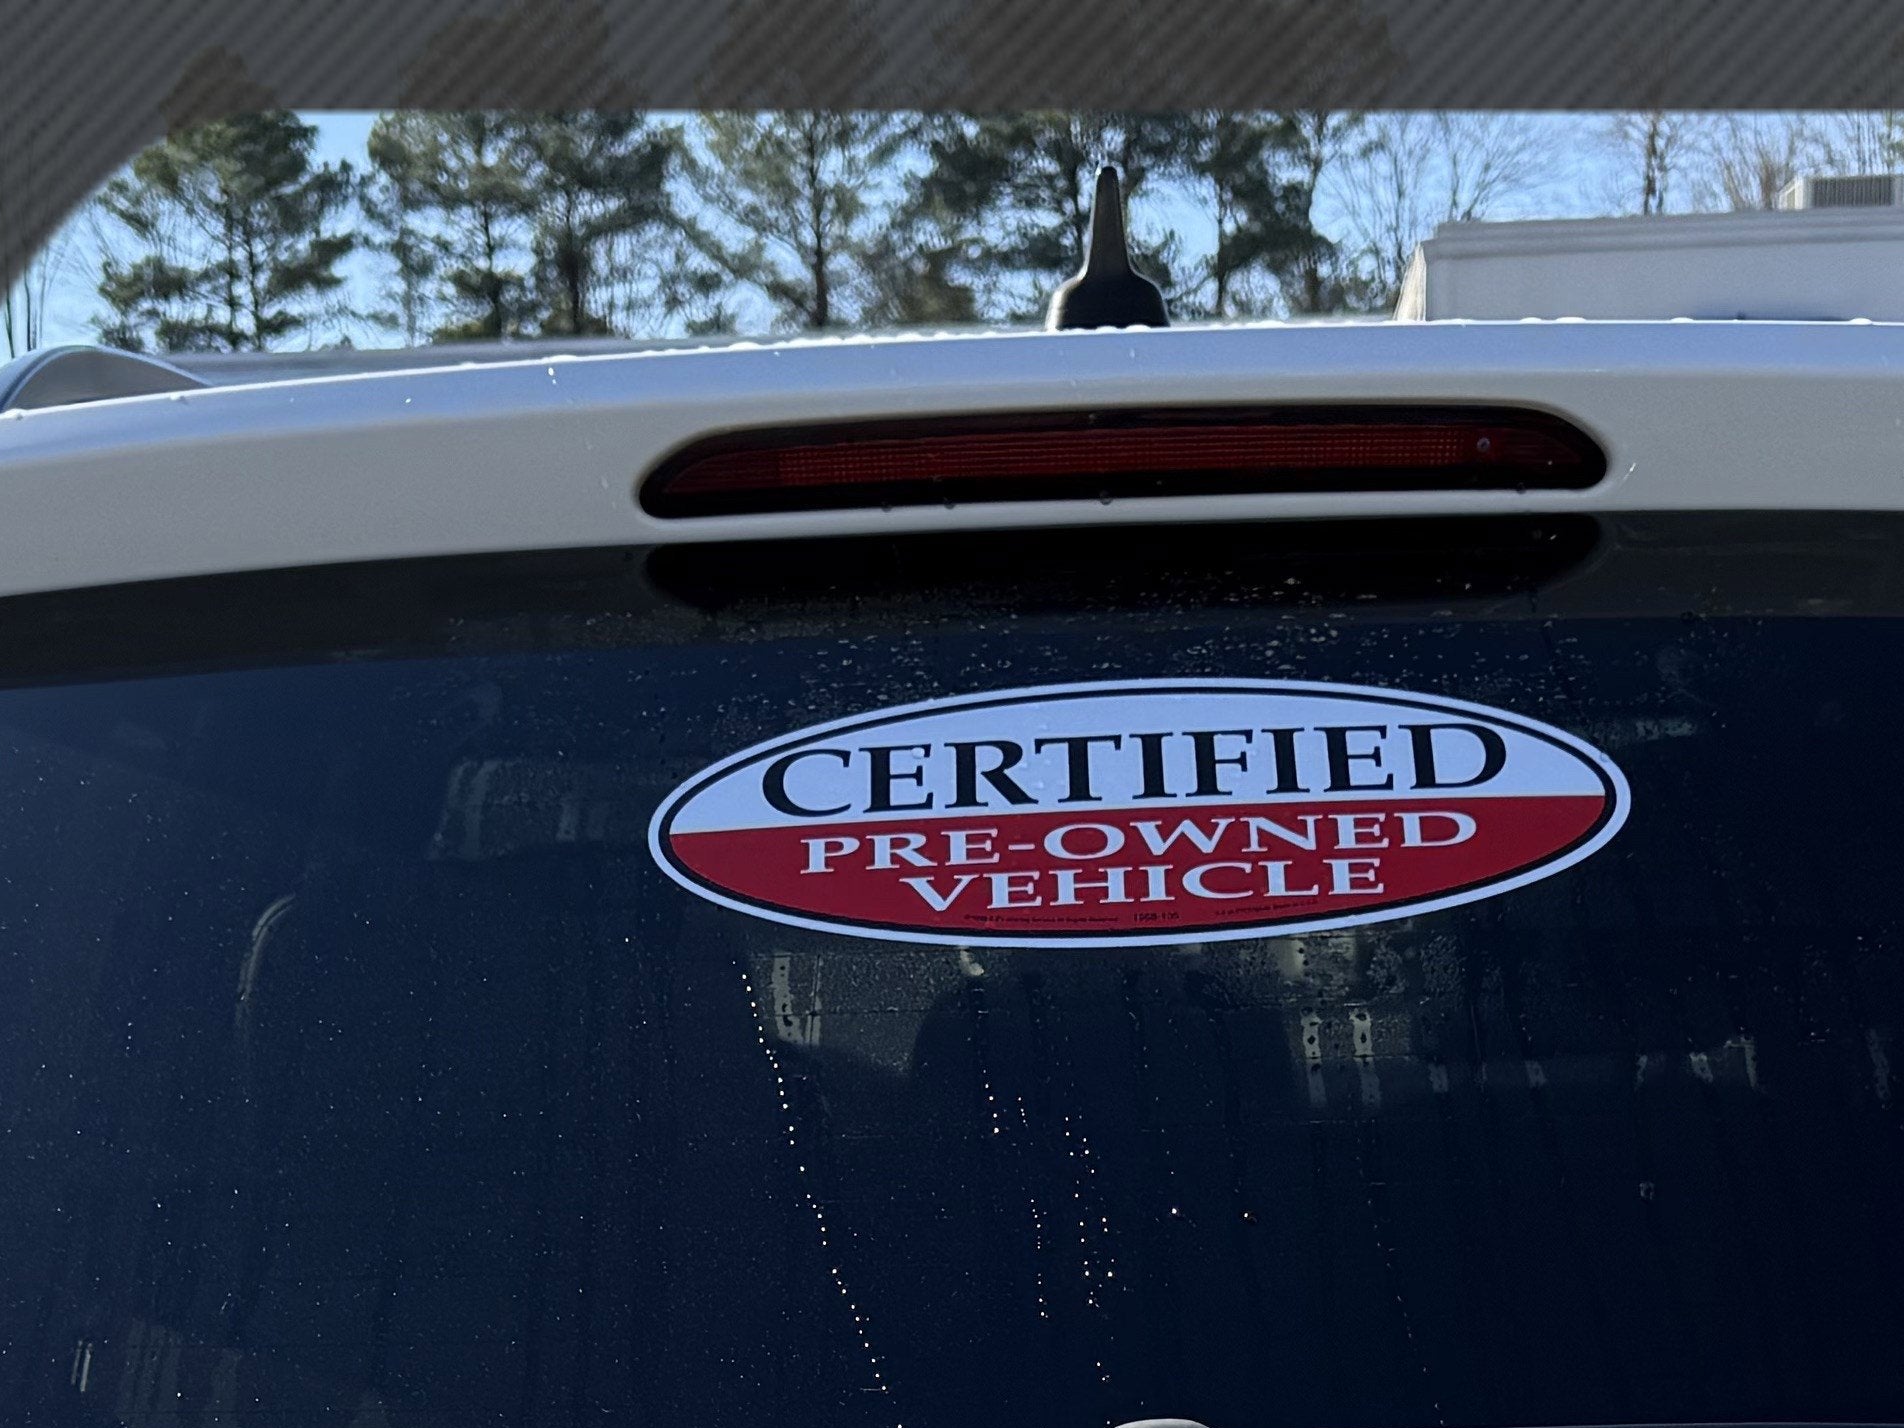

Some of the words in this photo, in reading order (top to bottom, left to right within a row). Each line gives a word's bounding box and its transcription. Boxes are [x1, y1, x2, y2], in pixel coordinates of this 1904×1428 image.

[761, 722, 1508, 818] CERTIFIED
[799, 810, 1478, 875] PRE-OWNED
[898, 857, 1385, 912] VEHICLE
